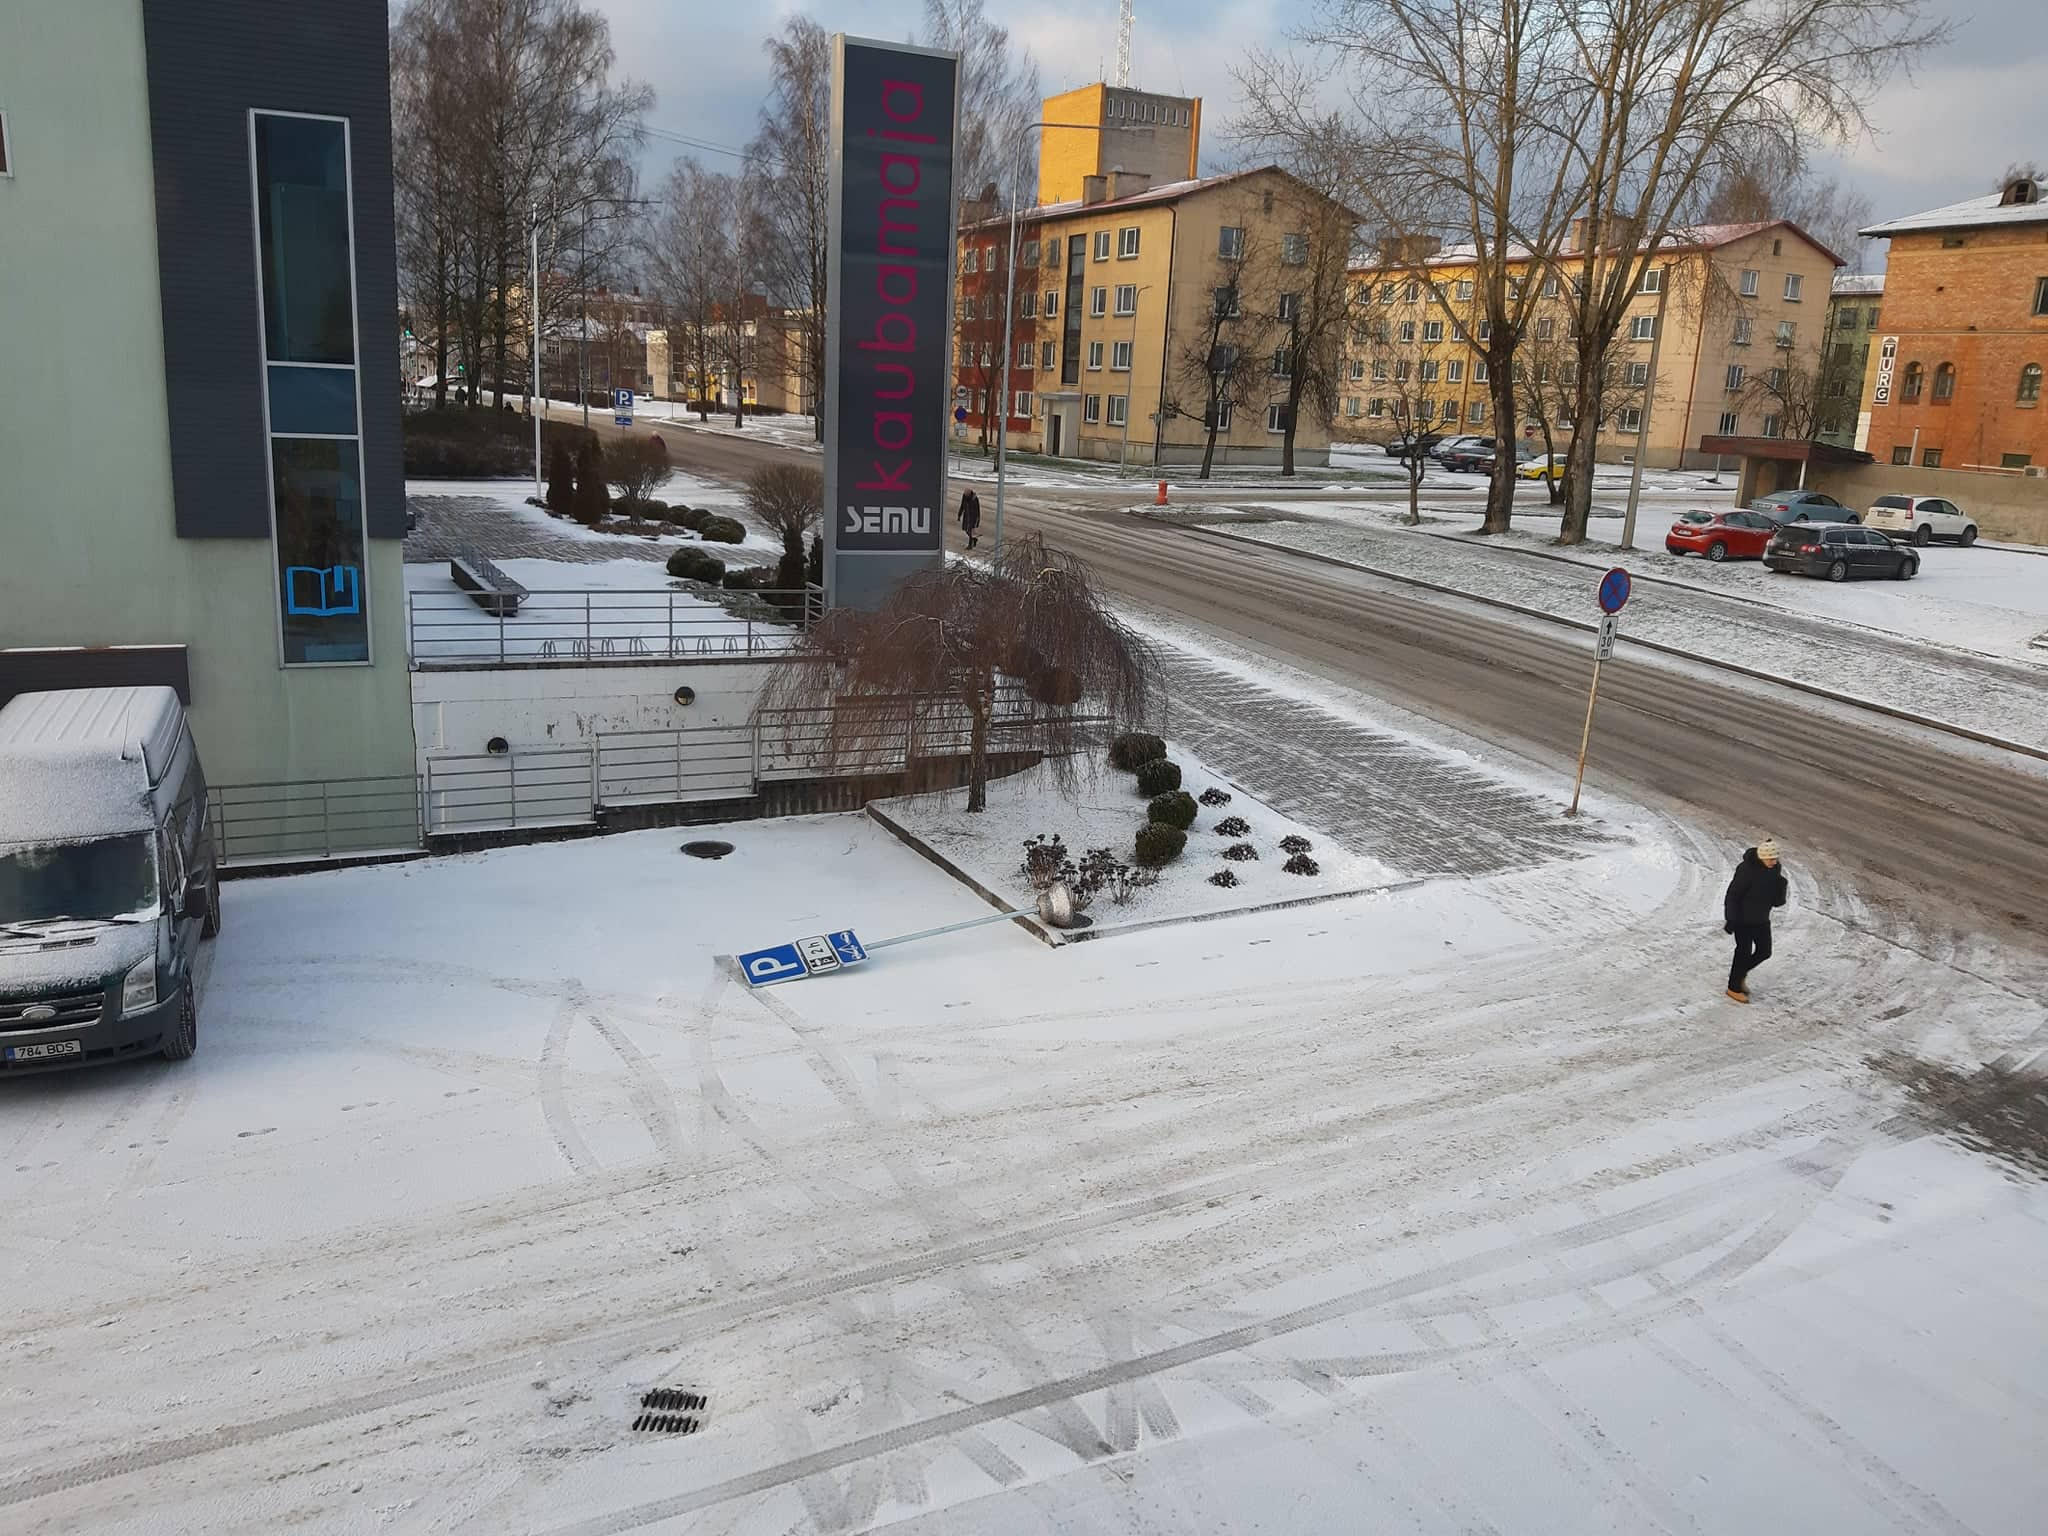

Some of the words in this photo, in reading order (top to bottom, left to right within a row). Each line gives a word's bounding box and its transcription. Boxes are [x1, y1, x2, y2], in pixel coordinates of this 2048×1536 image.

[855, 79, 938, 493] kaubamaja
[1877, 344, 1895, 399] TURG
[619, 391, 629, 405] P
[845, 506, 930, 533] SEMU
[1601, 636, 1613, 648] 30
[750, 956, 798, 977] P
[18, 1046, 42, 1058] 784
[46, 1042, 74, 1055] BDS
